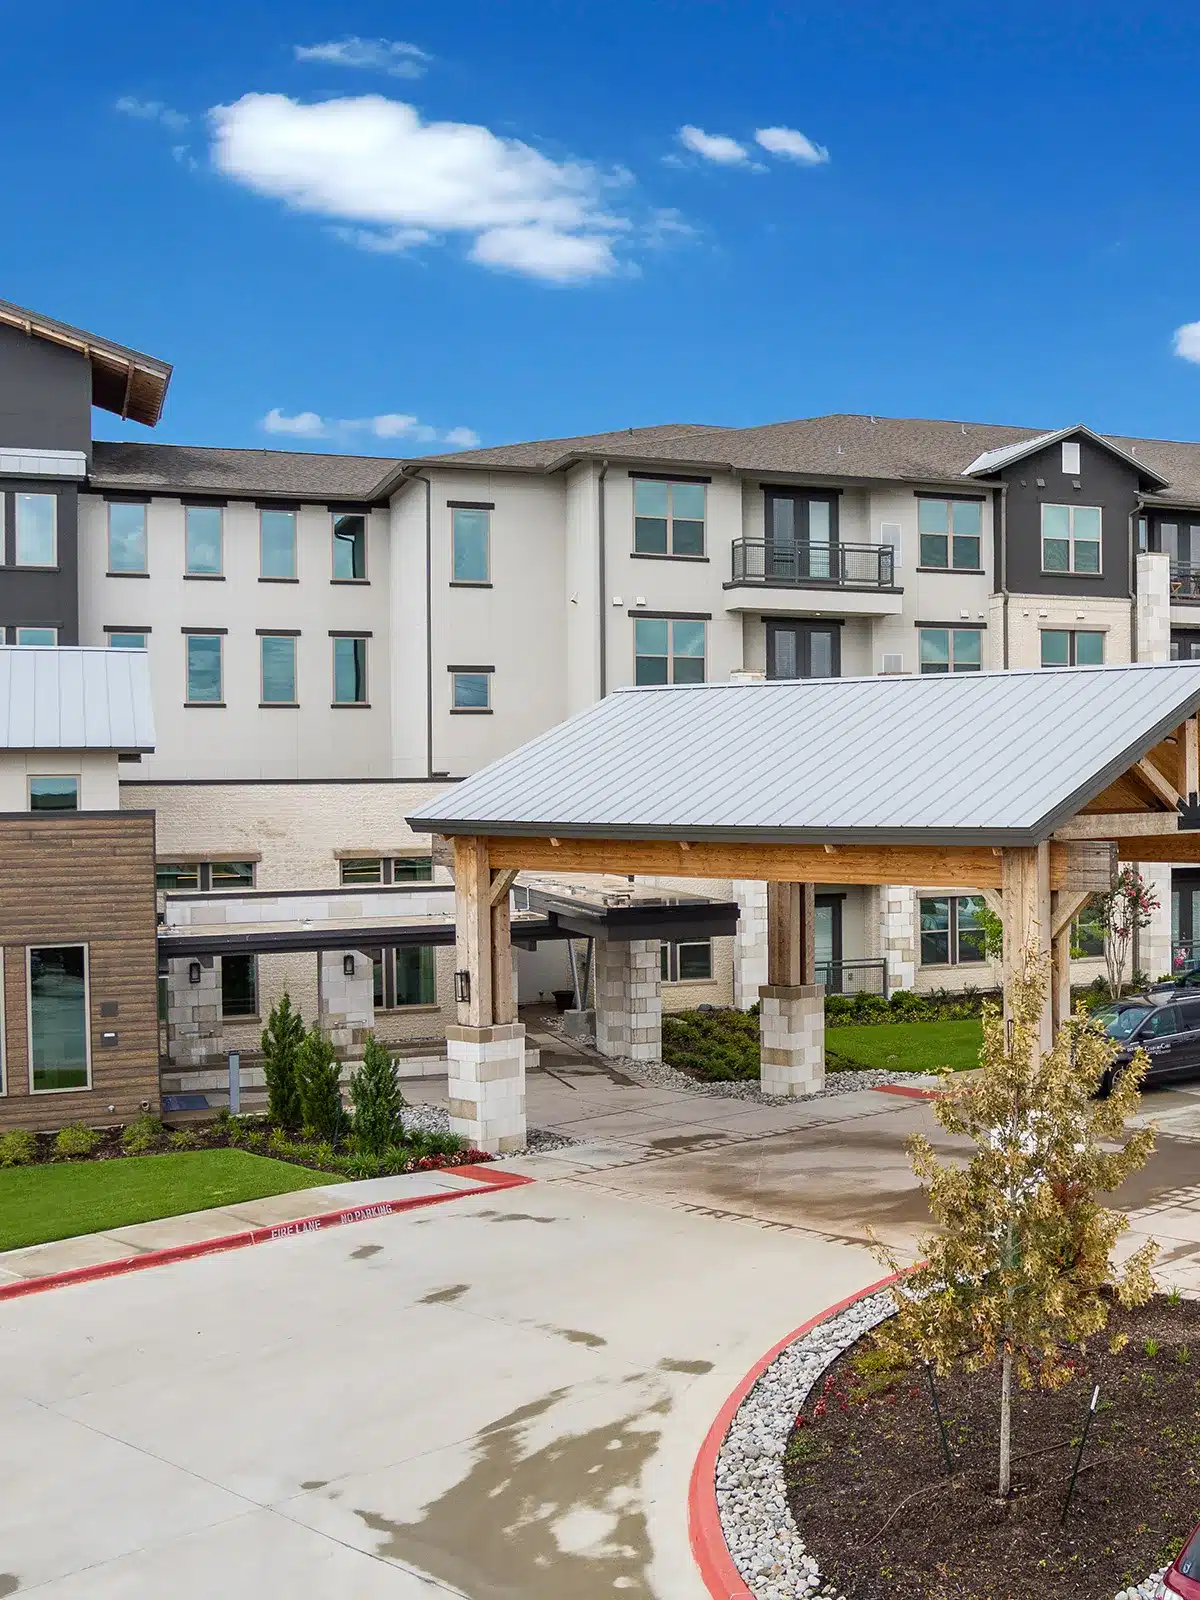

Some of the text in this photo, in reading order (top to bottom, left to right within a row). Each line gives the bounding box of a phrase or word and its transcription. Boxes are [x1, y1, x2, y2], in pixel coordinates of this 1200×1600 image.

[271, 1204, 393, 1239] FIRE LANE NO PARKING
